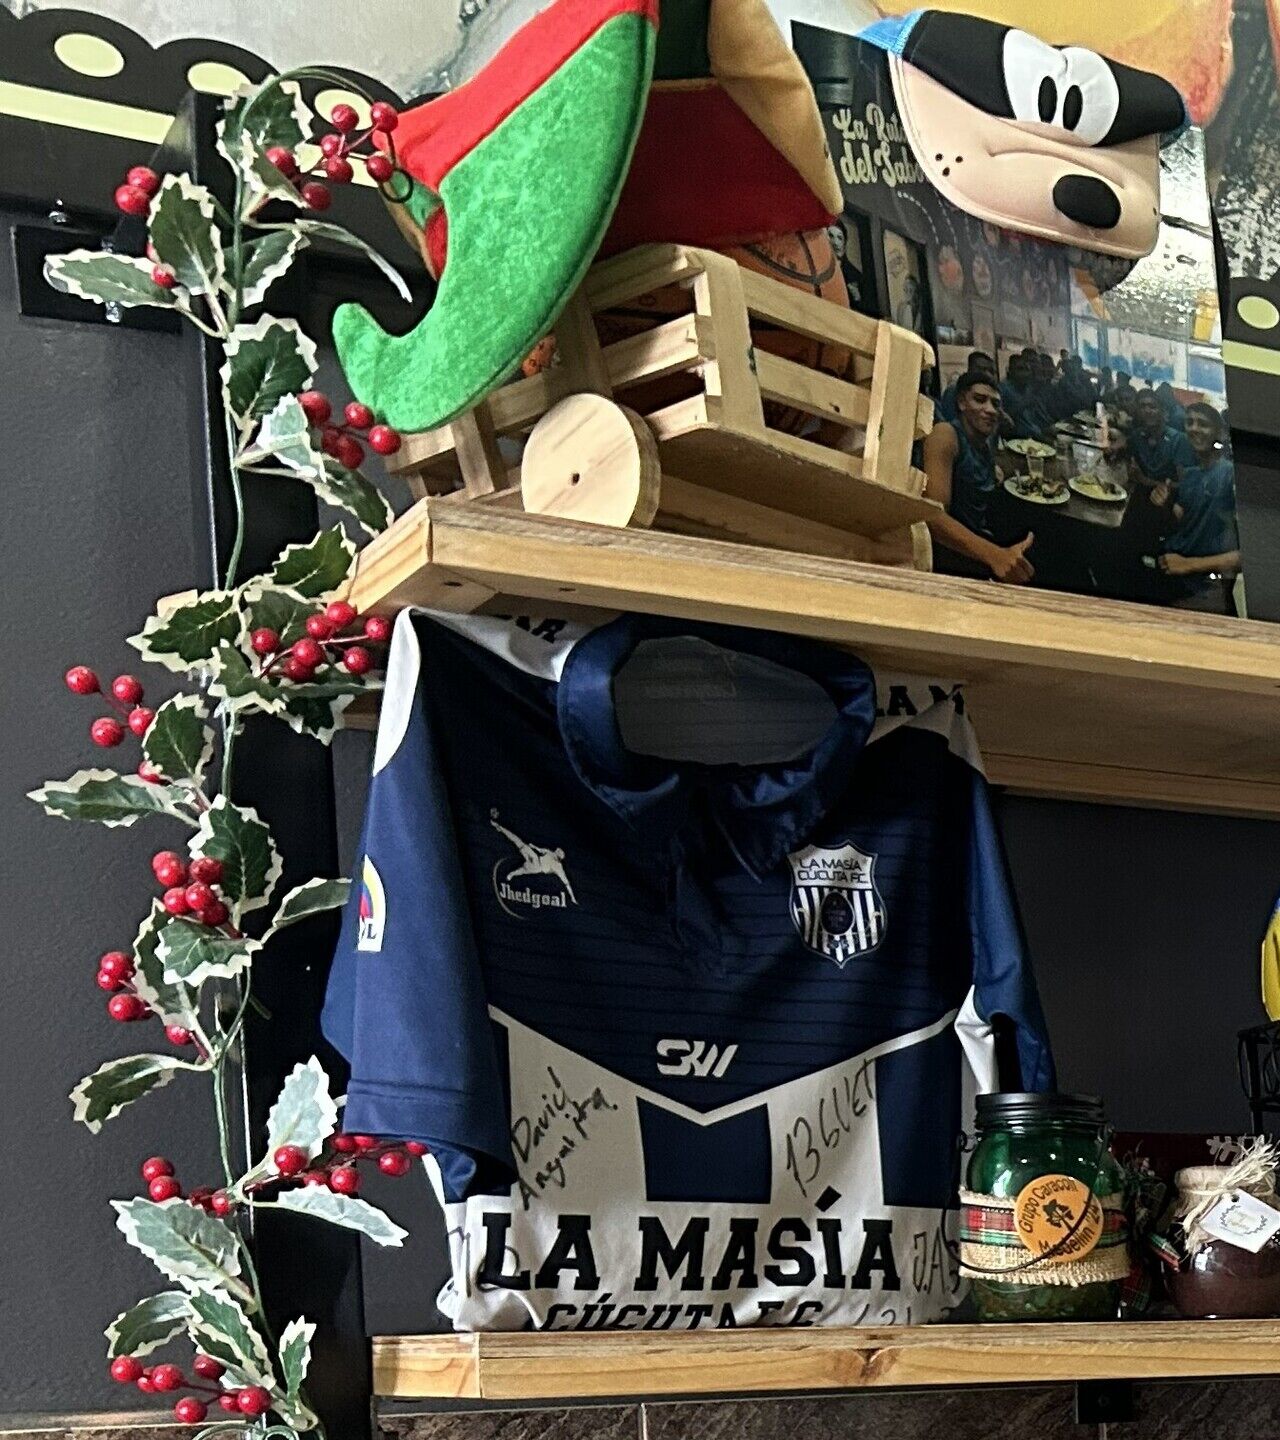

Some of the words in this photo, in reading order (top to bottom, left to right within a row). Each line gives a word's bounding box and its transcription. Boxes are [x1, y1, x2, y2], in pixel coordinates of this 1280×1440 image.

[480, 1212, 602, 1292] LA
[633, 1184, 900, 1292] MASÍA
[1018, 1197, 1040, 1234] Grupo
